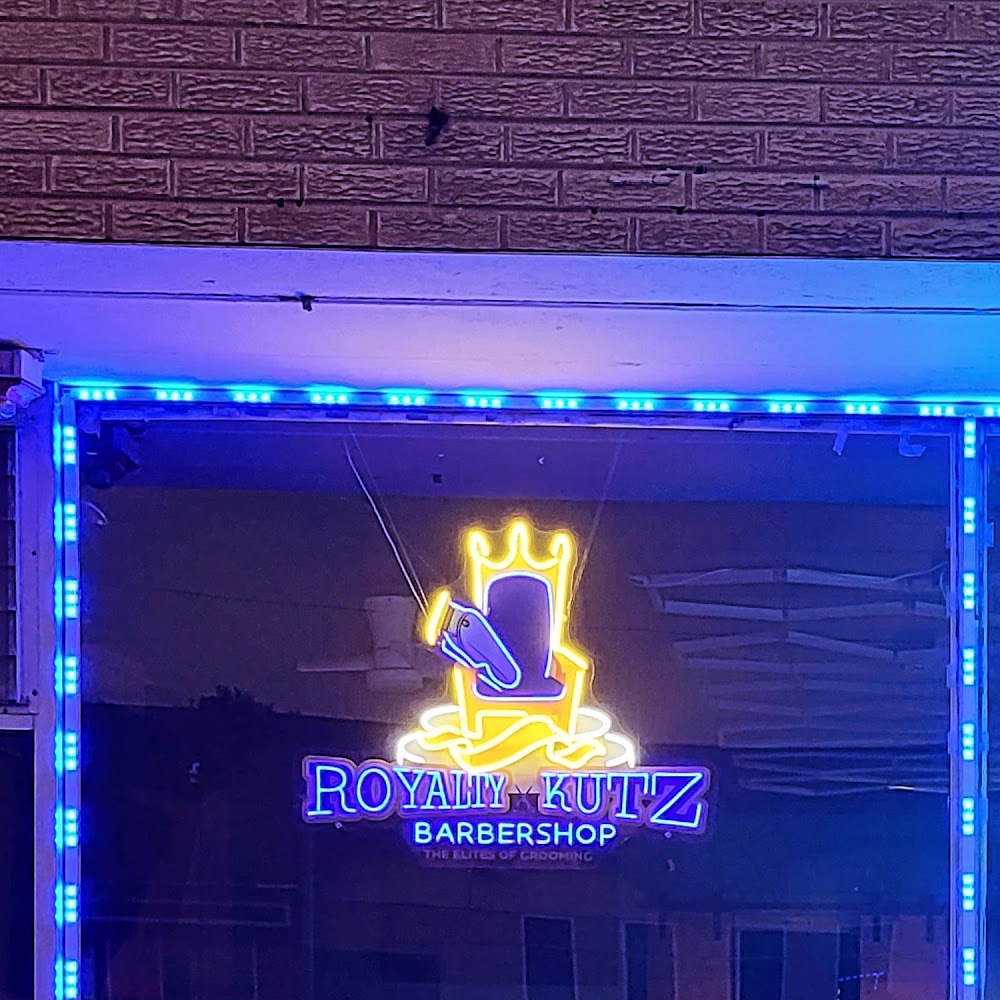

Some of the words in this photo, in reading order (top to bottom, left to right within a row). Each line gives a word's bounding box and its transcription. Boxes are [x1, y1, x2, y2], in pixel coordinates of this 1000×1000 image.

[304, 763, 508, 818] ROYALTY
[540, 769, 705, 829] KUTZ
[413, 821, 618, 848] BARBERSHOP
[423, 849, 449, 860] THE
[453, 850, 496, 861] ELITES
[499, 850, 518, 861] OF
[520, 850, 594, 862] GROOMING
